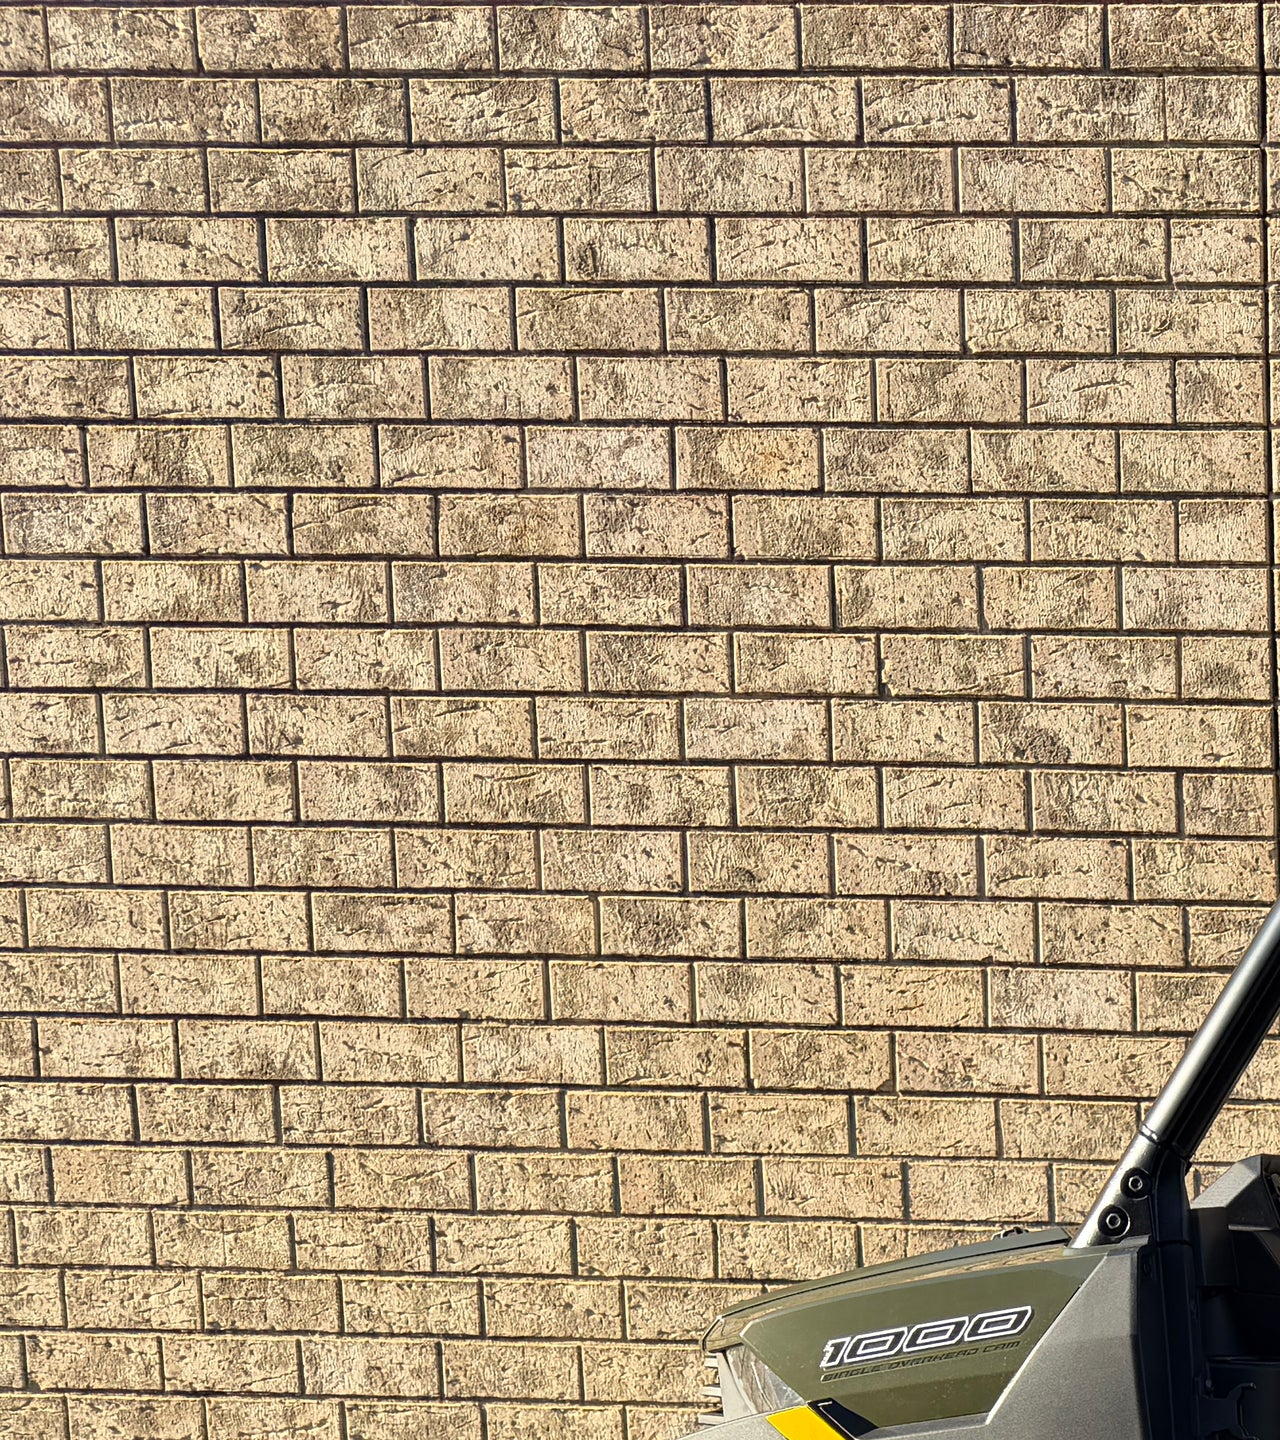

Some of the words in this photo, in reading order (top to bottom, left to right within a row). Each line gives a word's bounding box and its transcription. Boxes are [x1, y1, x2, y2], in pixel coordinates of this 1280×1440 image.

[820, 1306, 1034, 1369] 1000
[822, 1364, 884, 1382] SINGLE
[983, 1340, 1021, 1353] CAM
